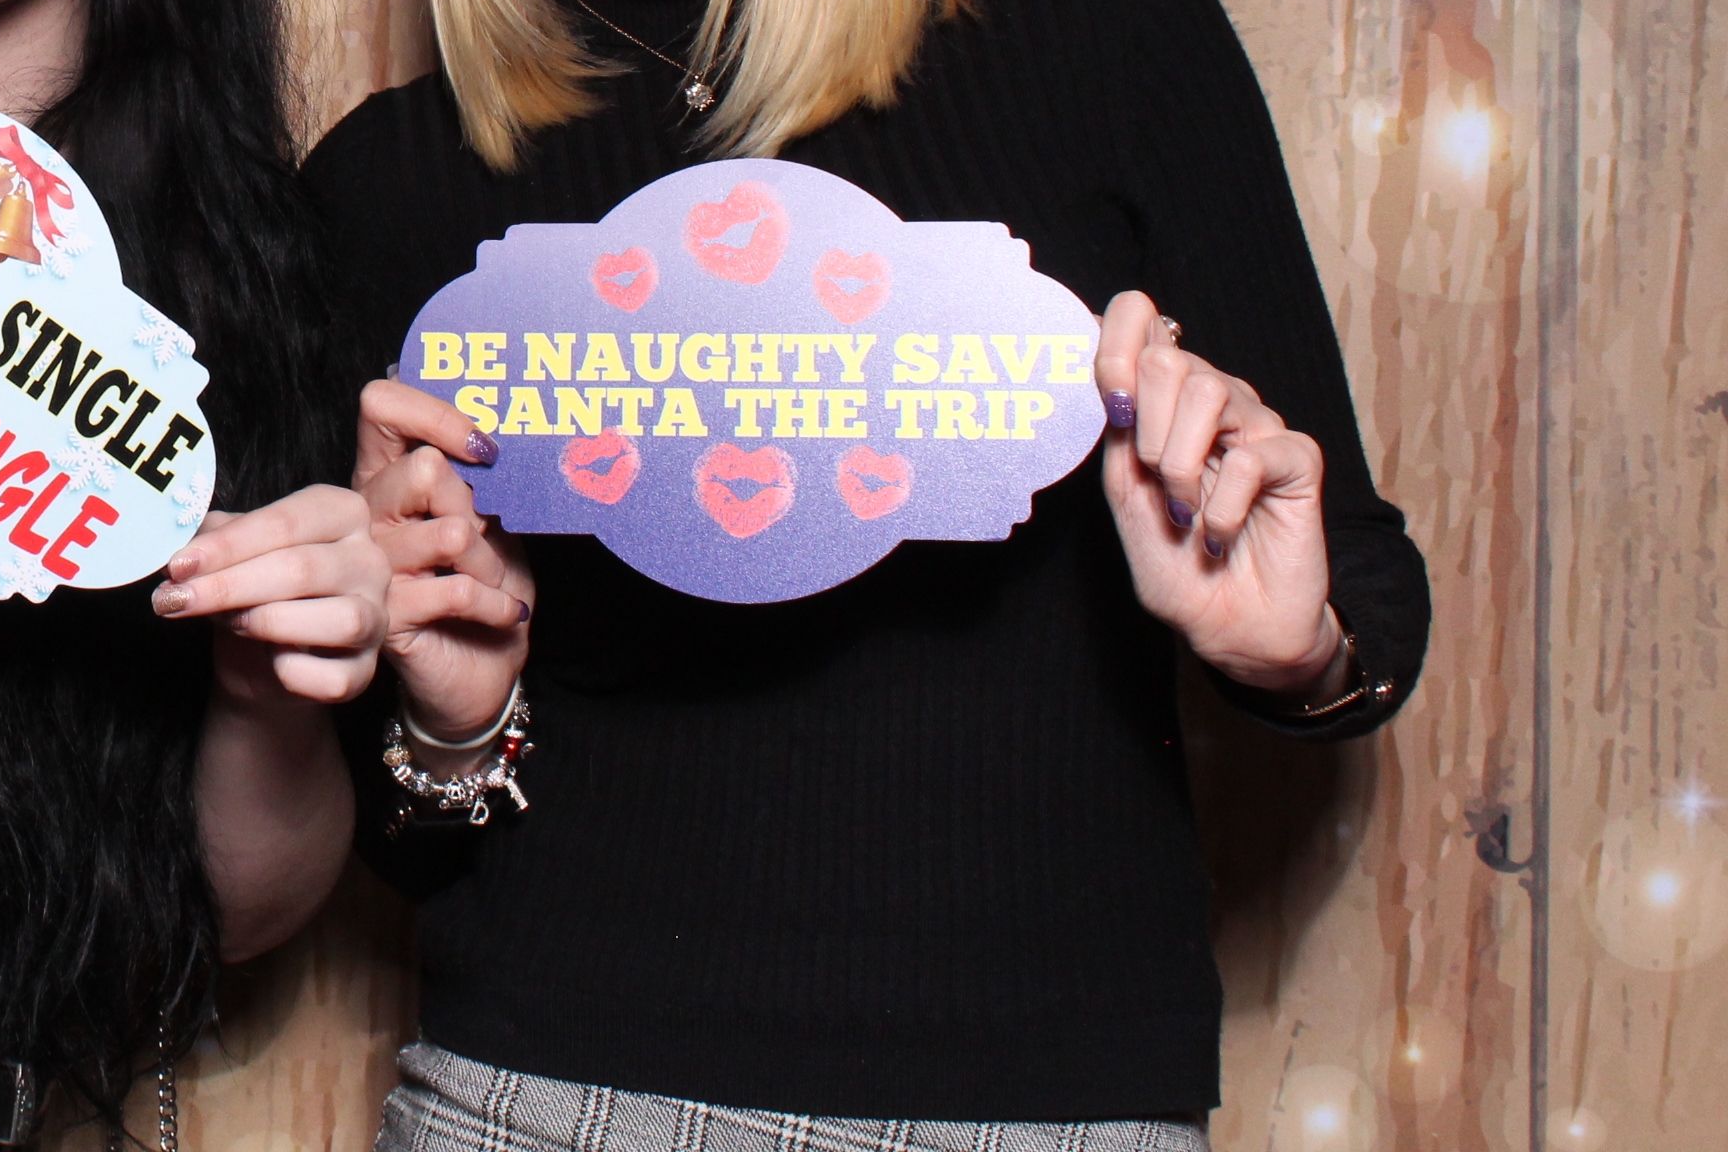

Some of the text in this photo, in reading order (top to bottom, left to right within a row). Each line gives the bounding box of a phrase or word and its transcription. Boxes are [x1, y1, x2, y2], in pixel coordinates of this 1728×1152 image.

[420, 332, 1091, 385] BE NAUGHTY SAVE
[455, 385, 1055, 441] SANTA THE TRIP
